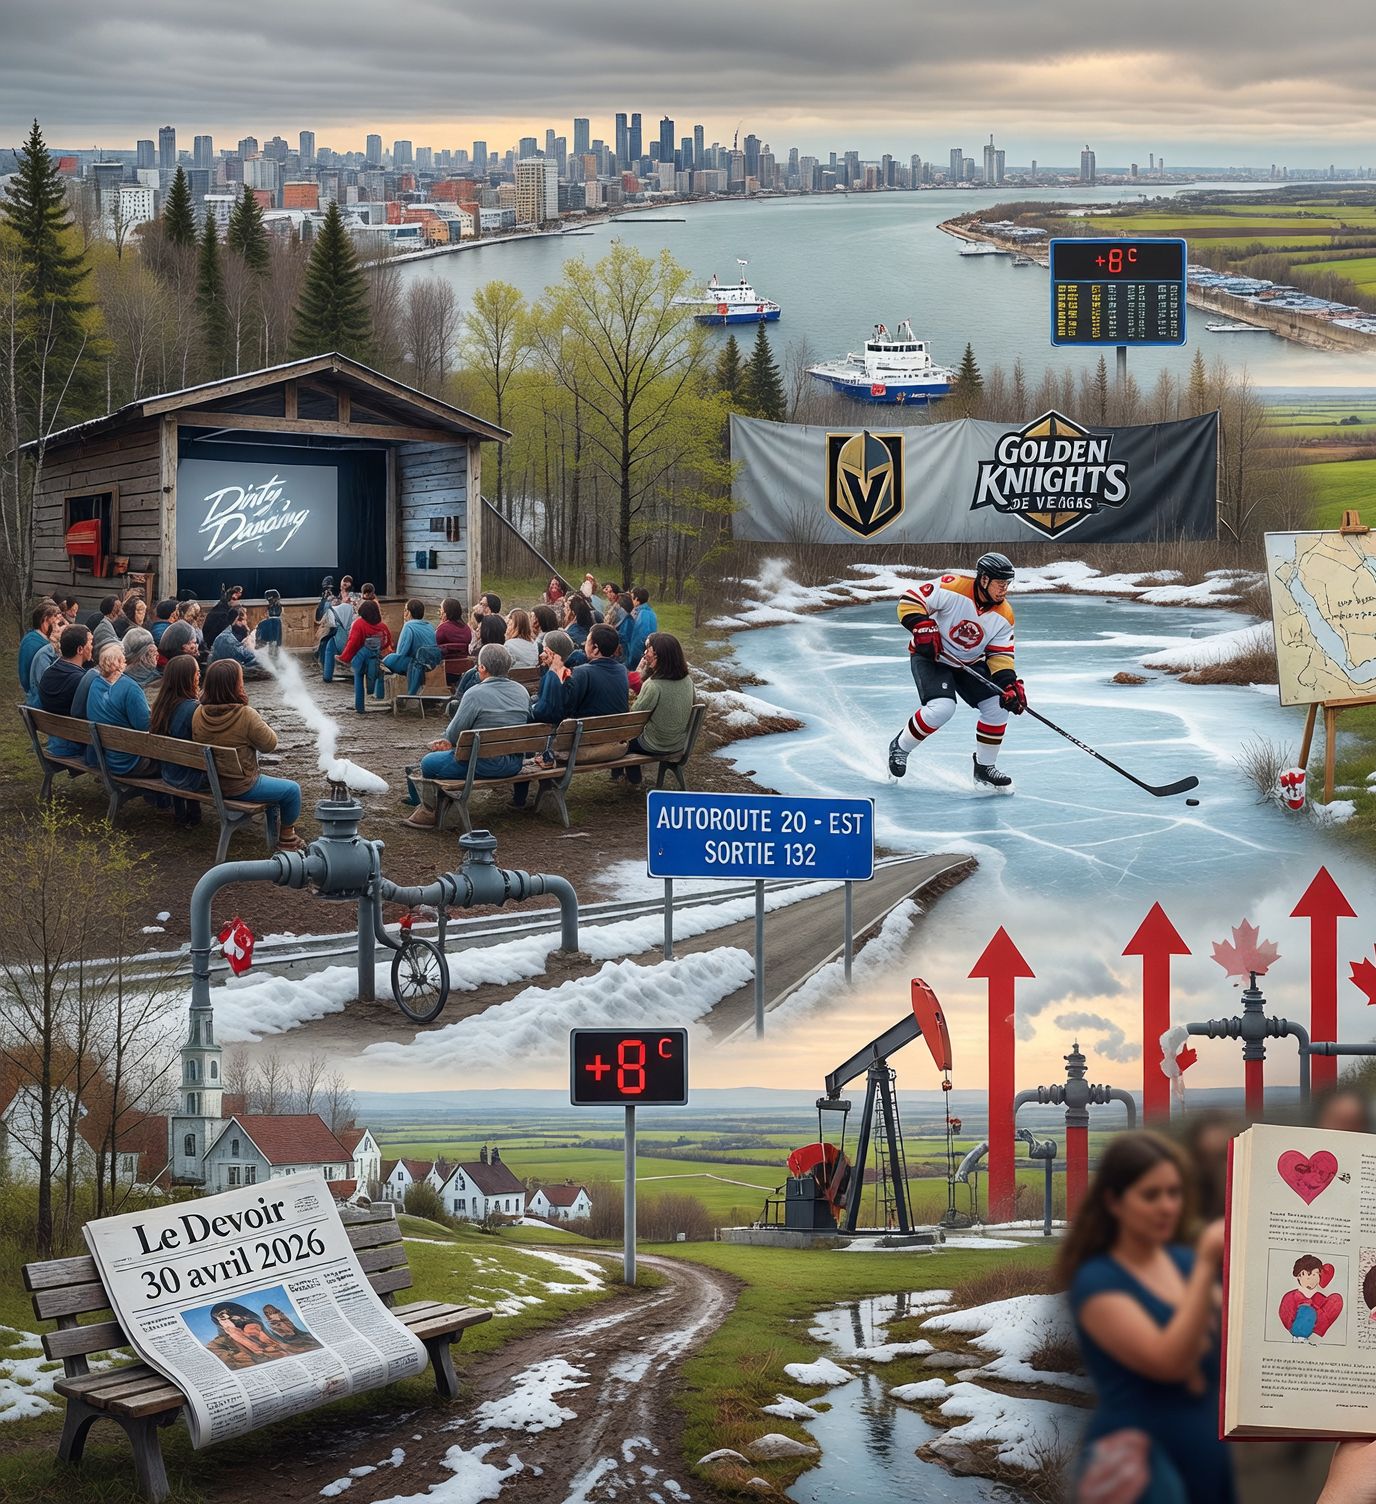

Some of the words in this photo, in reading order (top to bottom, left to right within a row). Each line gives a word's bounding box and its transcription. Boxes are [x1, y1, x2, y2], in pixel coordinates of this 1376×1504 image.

[998, 436, 1108, 464] GOLDEN
[656, 806, 771, 832] AUTOROUTE
[780, 810, 807, 833] 20
[829, 813, 864, 834] EST
[704, 840, 775, 865] SORTIE
[783, 843, 816, 866] 132
[132, 1223, 181, 1255] Le
[178, 1197, 286, 1245] Devoir
[141, 1266, 181, 1300] 30
[187, 1247, 254, 1289] avril
[255, 1228, 326, 1270] 2026
